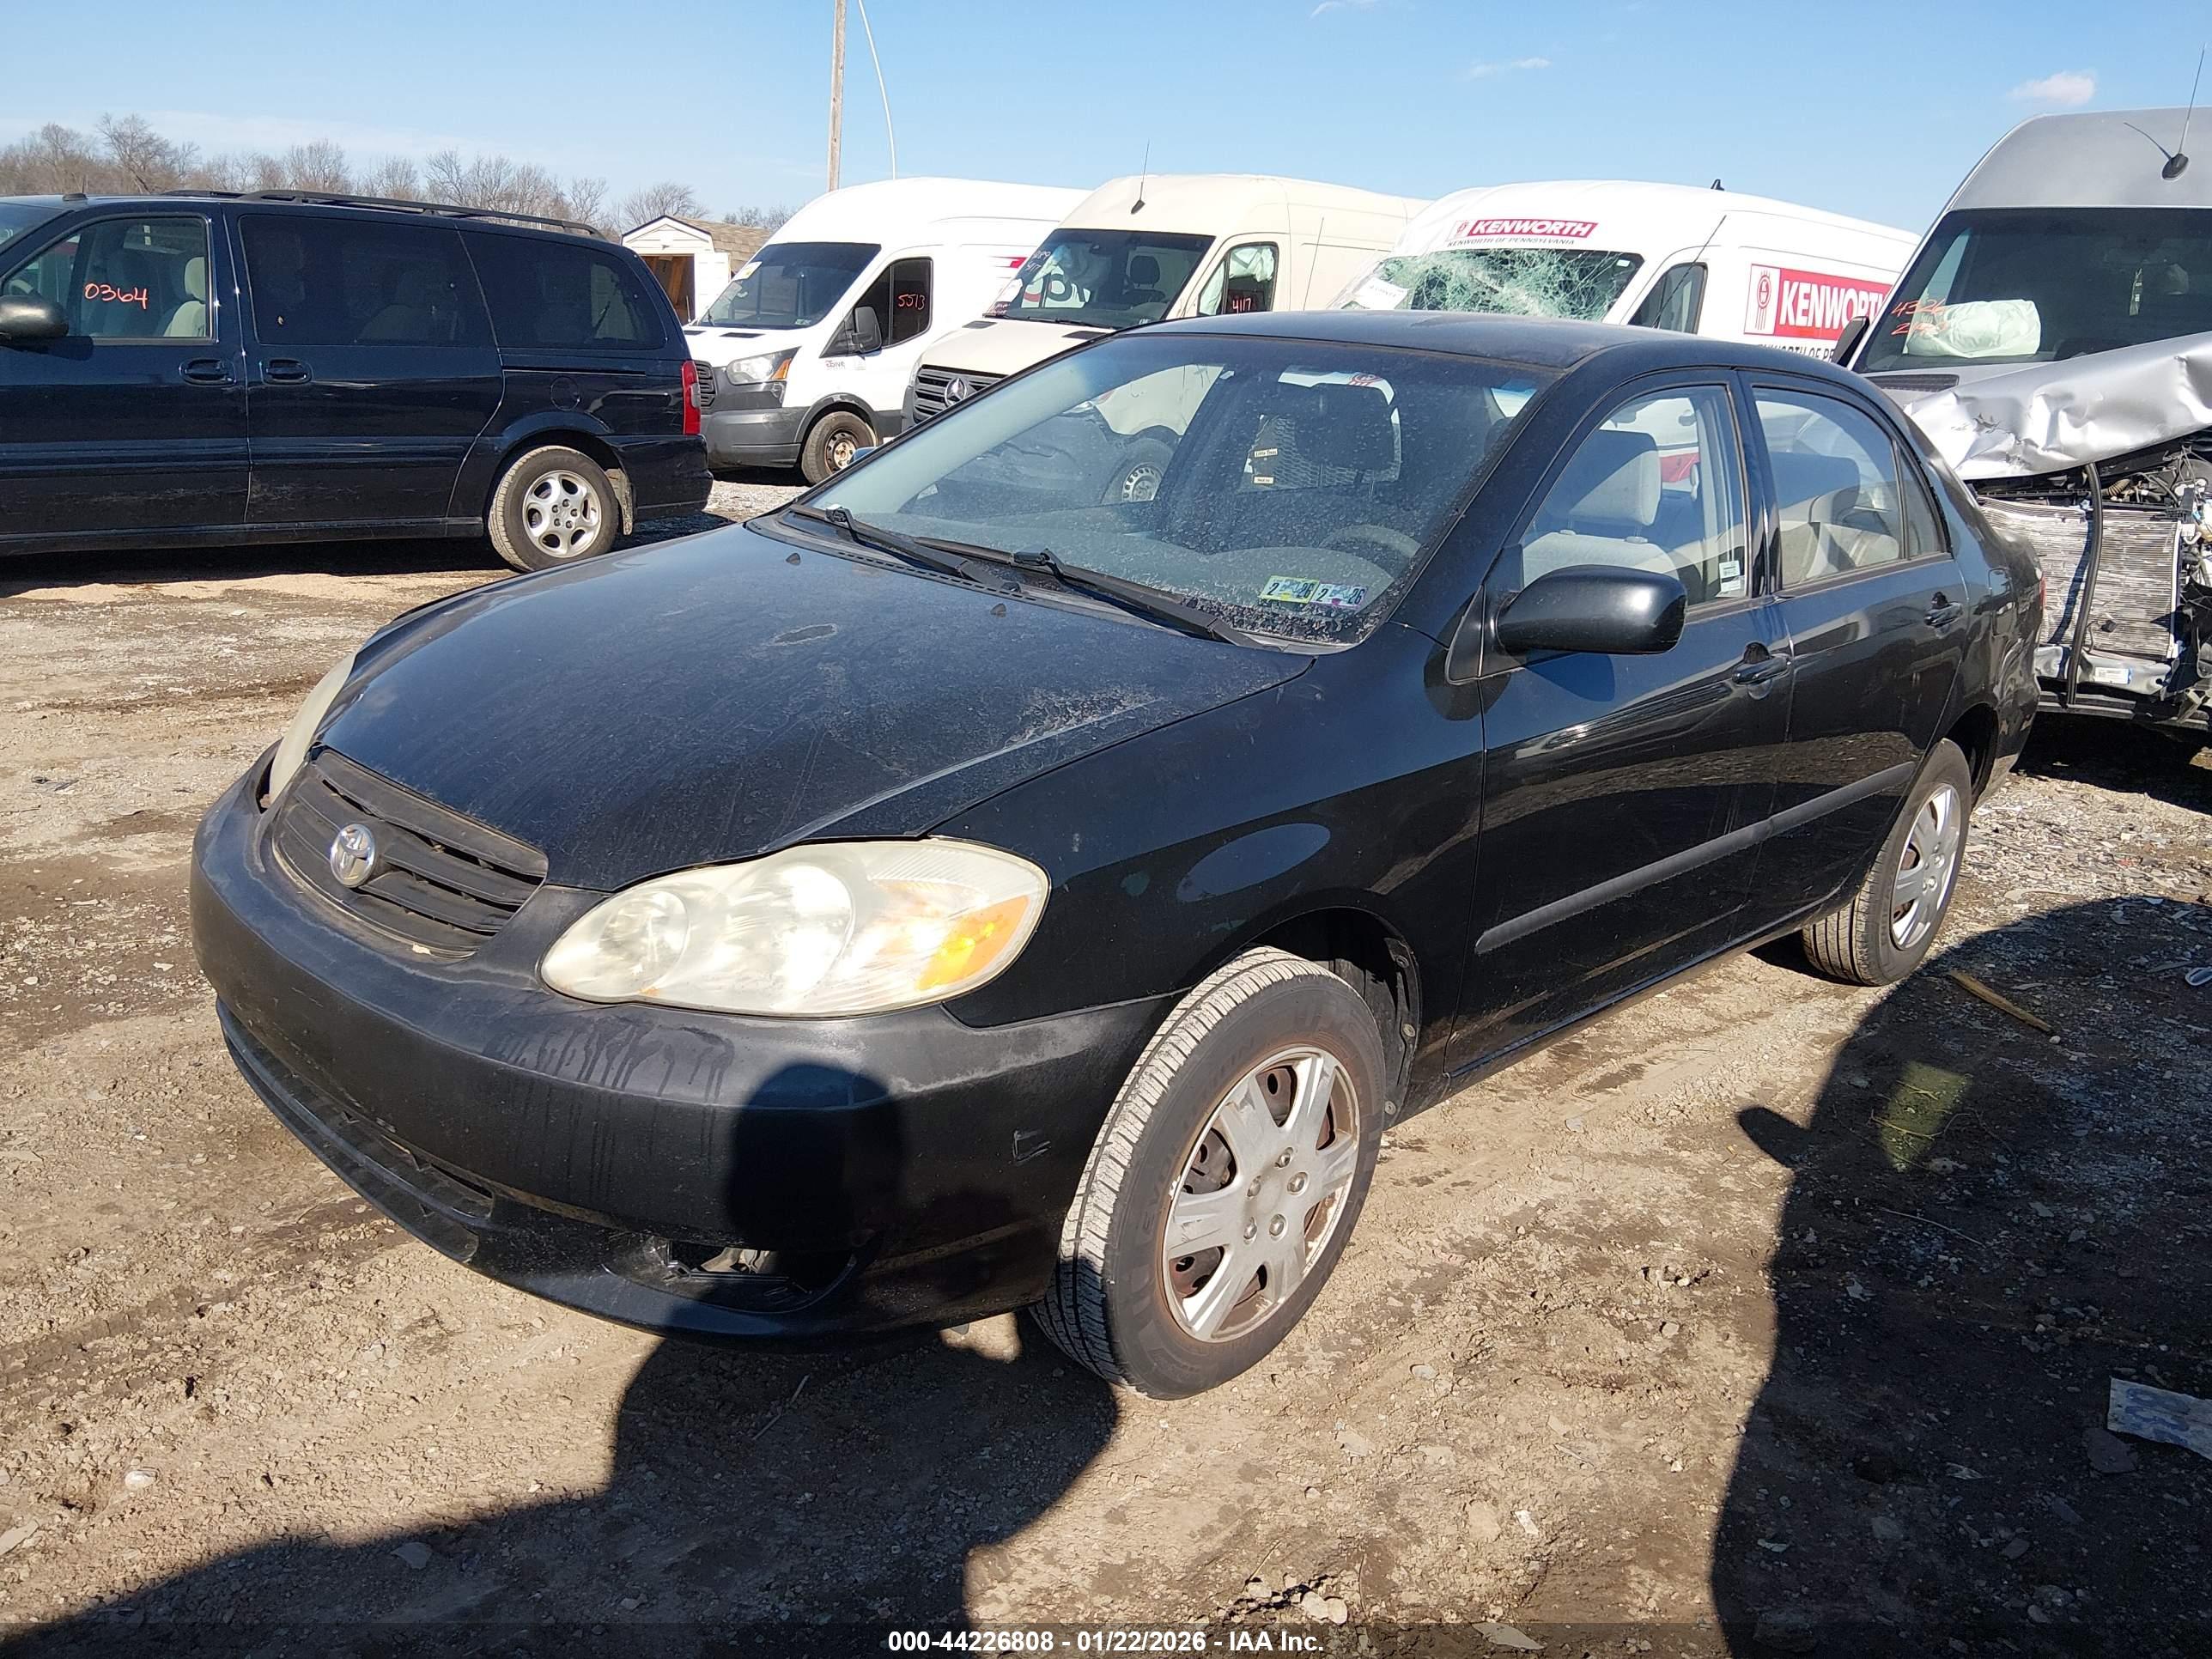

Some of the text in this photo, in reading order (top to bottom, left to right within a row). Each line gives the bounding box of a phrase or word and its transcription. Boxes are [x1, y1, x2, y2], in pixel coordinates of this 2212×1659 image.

[1472, 220, 1593, 236] KENWORTH
[1447, 238, 1493, 247] KENWORTH
[1508, 237, 1575, 246] PENNSYLVANIA
[84, 283, 148, 310] 0364
[898, 294, 926, 310] 5513
[1232, 297, 1251, 314] 4117
[1267, 582, 1315, 599] 2 26
[1316, 588, 1365, 605] 2 26
